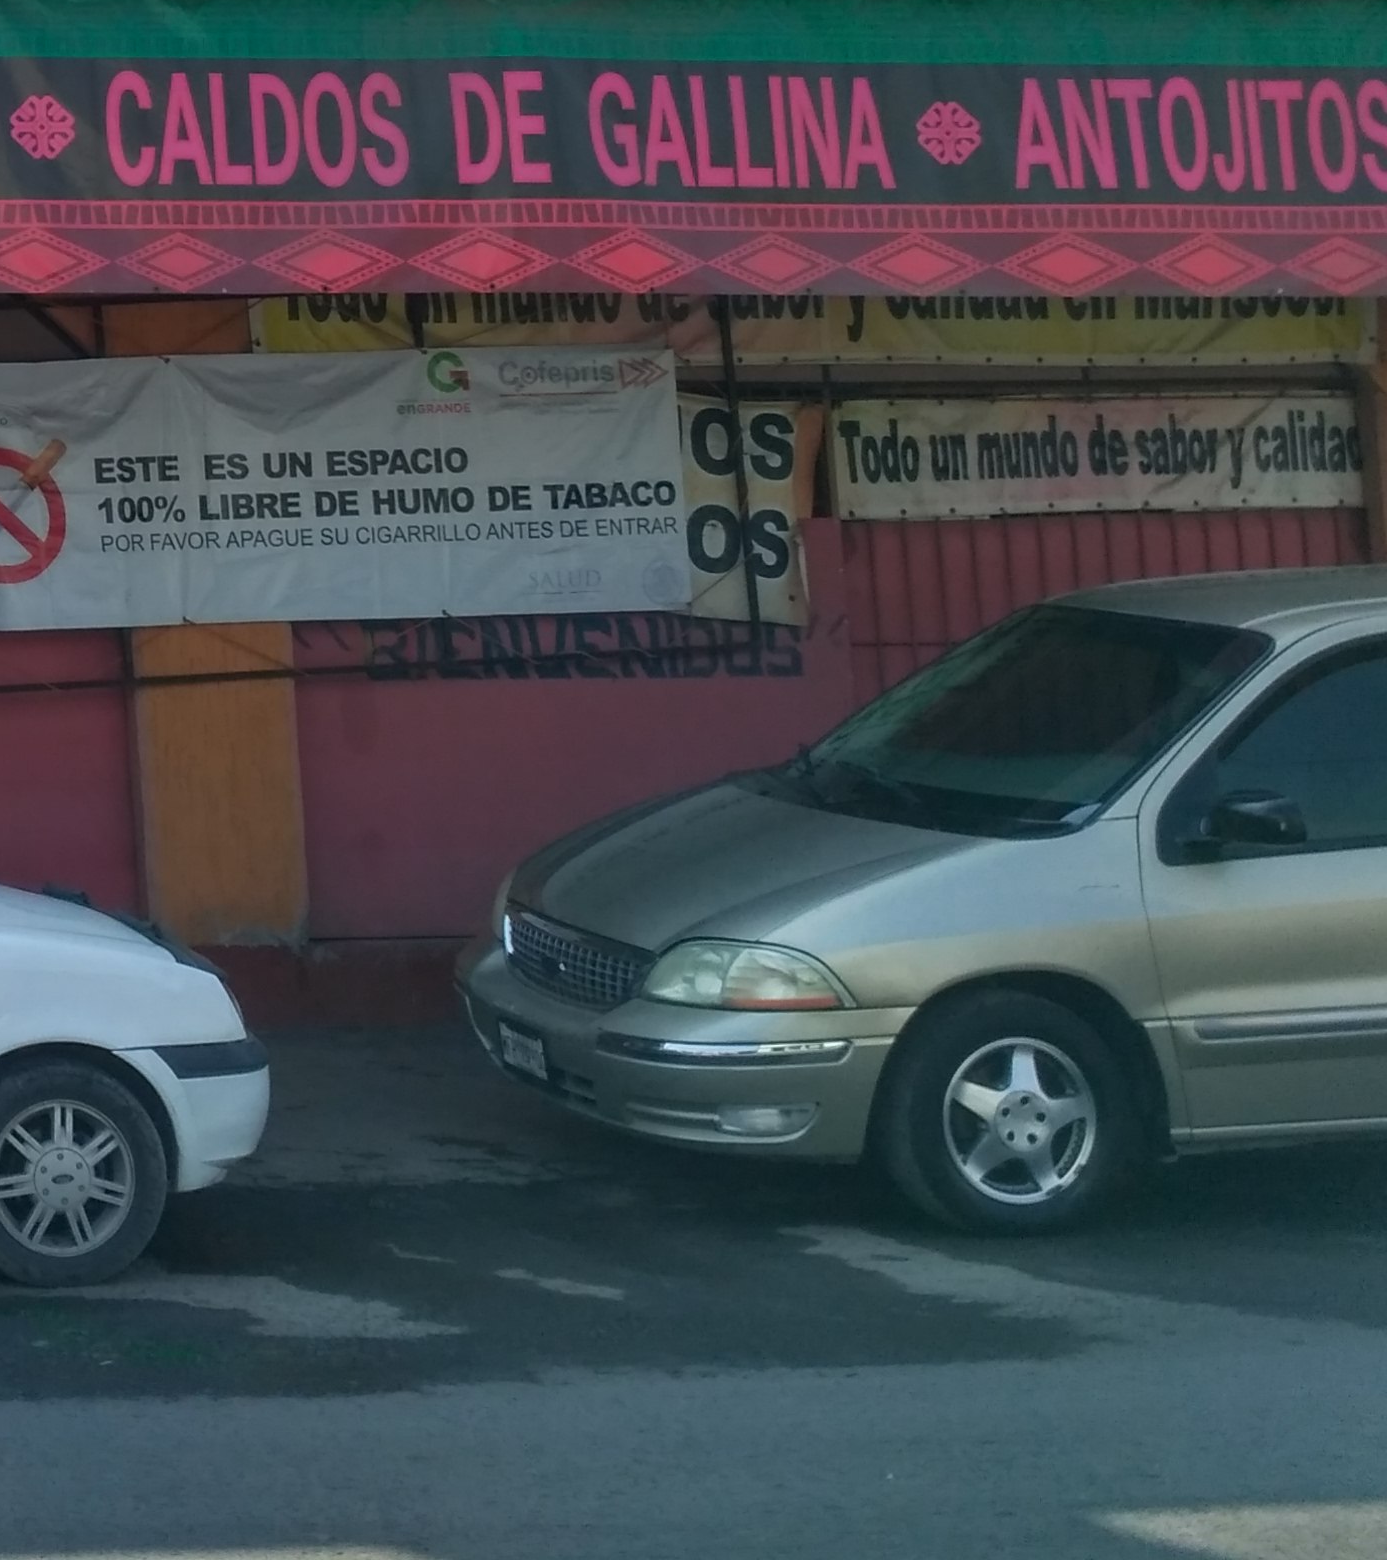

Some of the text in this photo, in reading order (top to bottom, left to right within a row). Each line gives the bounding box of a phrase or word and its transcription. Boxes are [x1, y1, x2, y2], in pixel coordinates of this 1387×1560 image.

[106, 71, 410, 187] CALDOS
[449, 70, 552, 185] DE
[588, 71, 896, 189] GALLINA
[1016, 76, 1387, 192] ANTOJITOS
[498, 359, 615, 389] Cofepris
[678, 407, 795, 481] OS
[837, 418, 920, 484] Todo
[929, 433, 970, 482] un
[977, 414, 1078, 480] mundo
[1088, 413, 1128, 476] de
[1135, 412, 1218, 475] sabor
[1226, 426, 1245, 489] y
[94, 446, 469, 484] ESTE ES UN ESPACIO
[97, 480, 677, 524] 100% LIBRE DE HUMO DE TABACO
[100, 515, 679, 553] POR FAVOR APAGUE SU CIGARRILLO ANTES DE ENTRAR
[528, 569, 602, 589] SALUD
